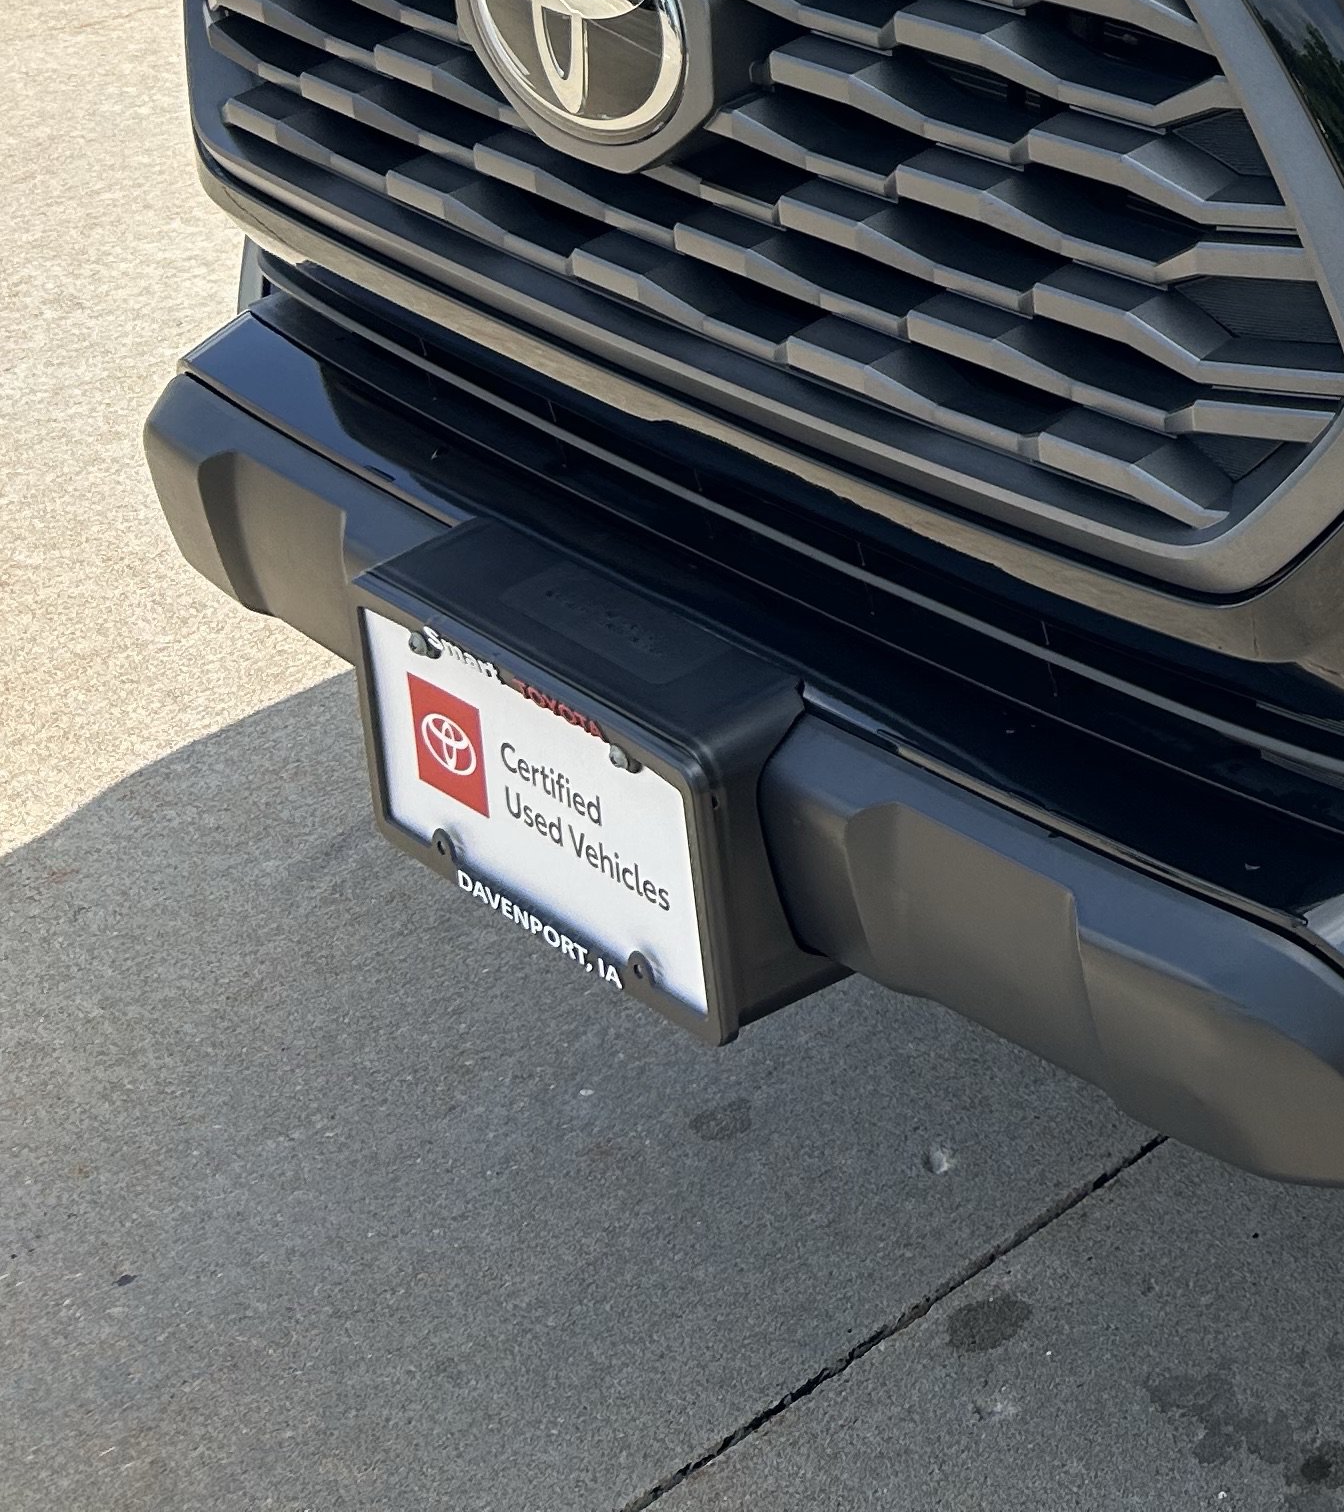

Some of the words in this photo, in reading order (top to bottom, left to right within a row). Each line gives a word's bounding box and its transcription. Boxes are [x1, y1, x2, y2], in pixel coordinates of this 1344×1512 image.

[422, 626, 499, 679] Smart
[512, 677, 601, 738] TOYOTA
[500, 742, 602, 827] Certified
[505, 785, 563, 847] Used
[568, 824, 670, 911] Vehicles
[457, 870, 593, 972] DAVENPORT,
[598, 957, 623, 989] IA
